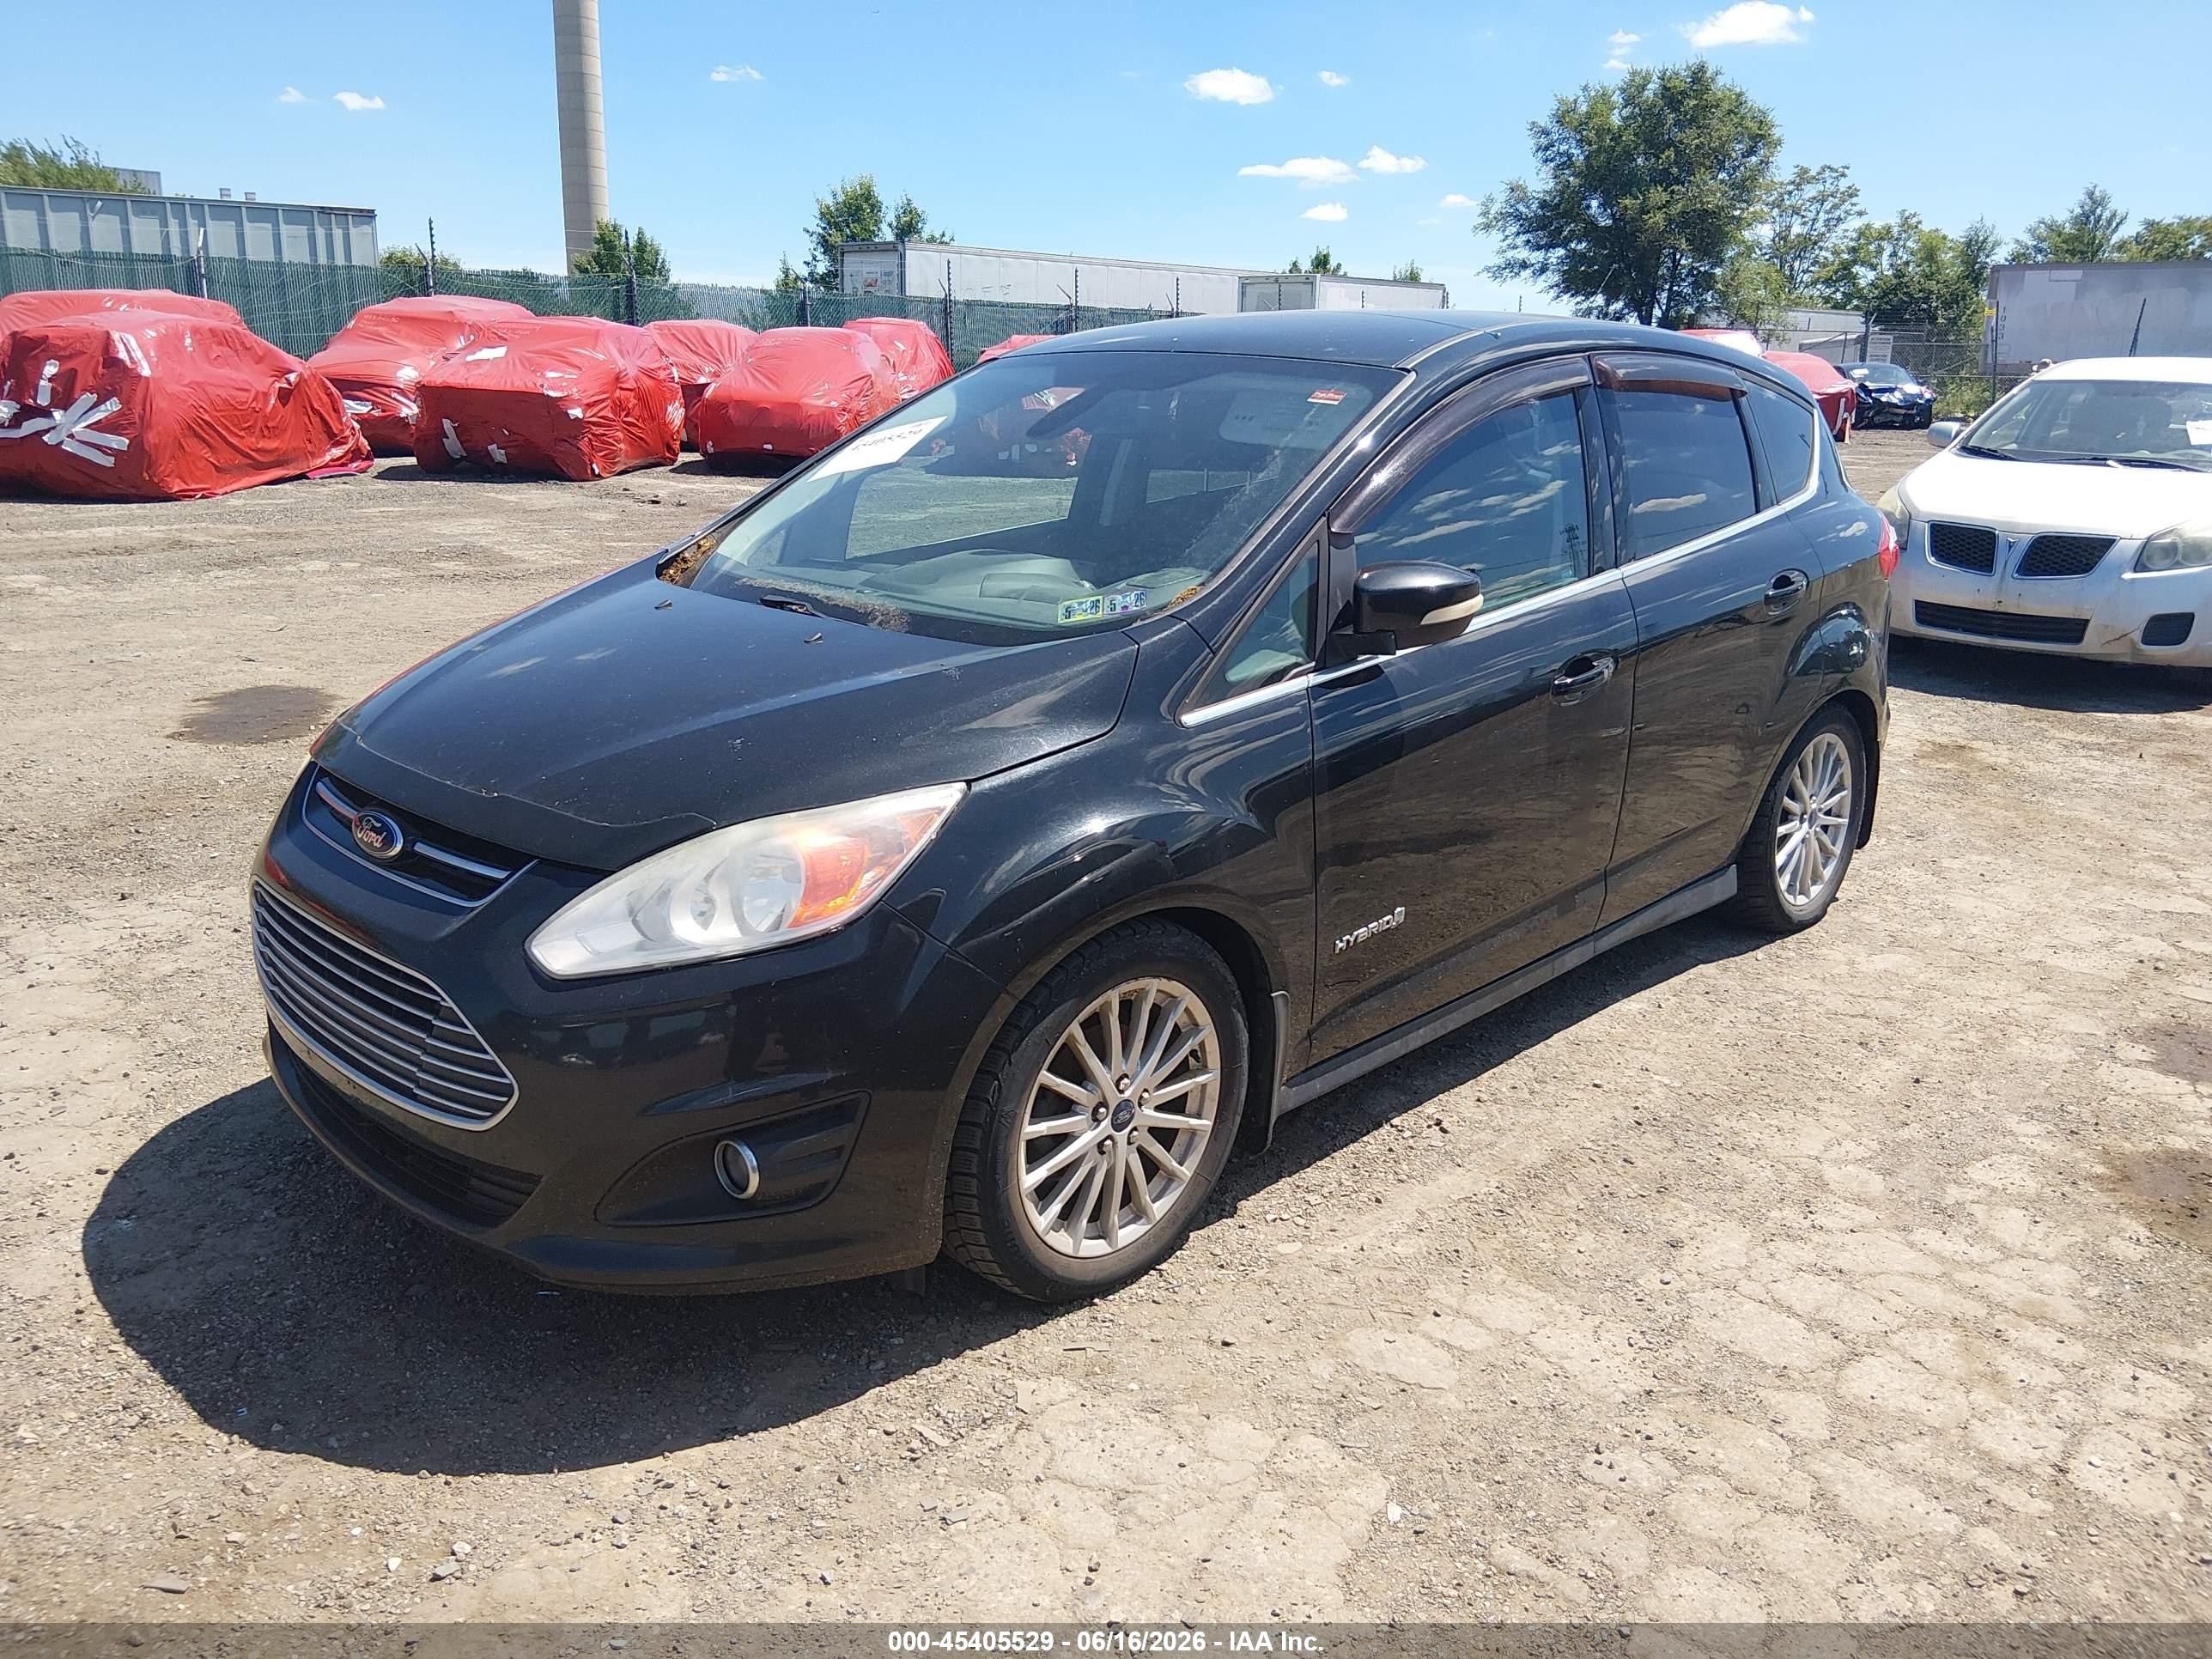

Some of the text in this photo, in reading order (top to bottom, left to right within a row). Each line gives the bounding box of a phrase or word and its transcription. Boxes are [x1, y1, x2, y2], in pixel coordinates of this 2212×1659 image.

[1089, 599, 1100, 615] 26
[1109, 592, 1146, 612] 5 26
[357, 817, 387, 848] Ford
[1334, 915, 1393, 954] HYBRID
